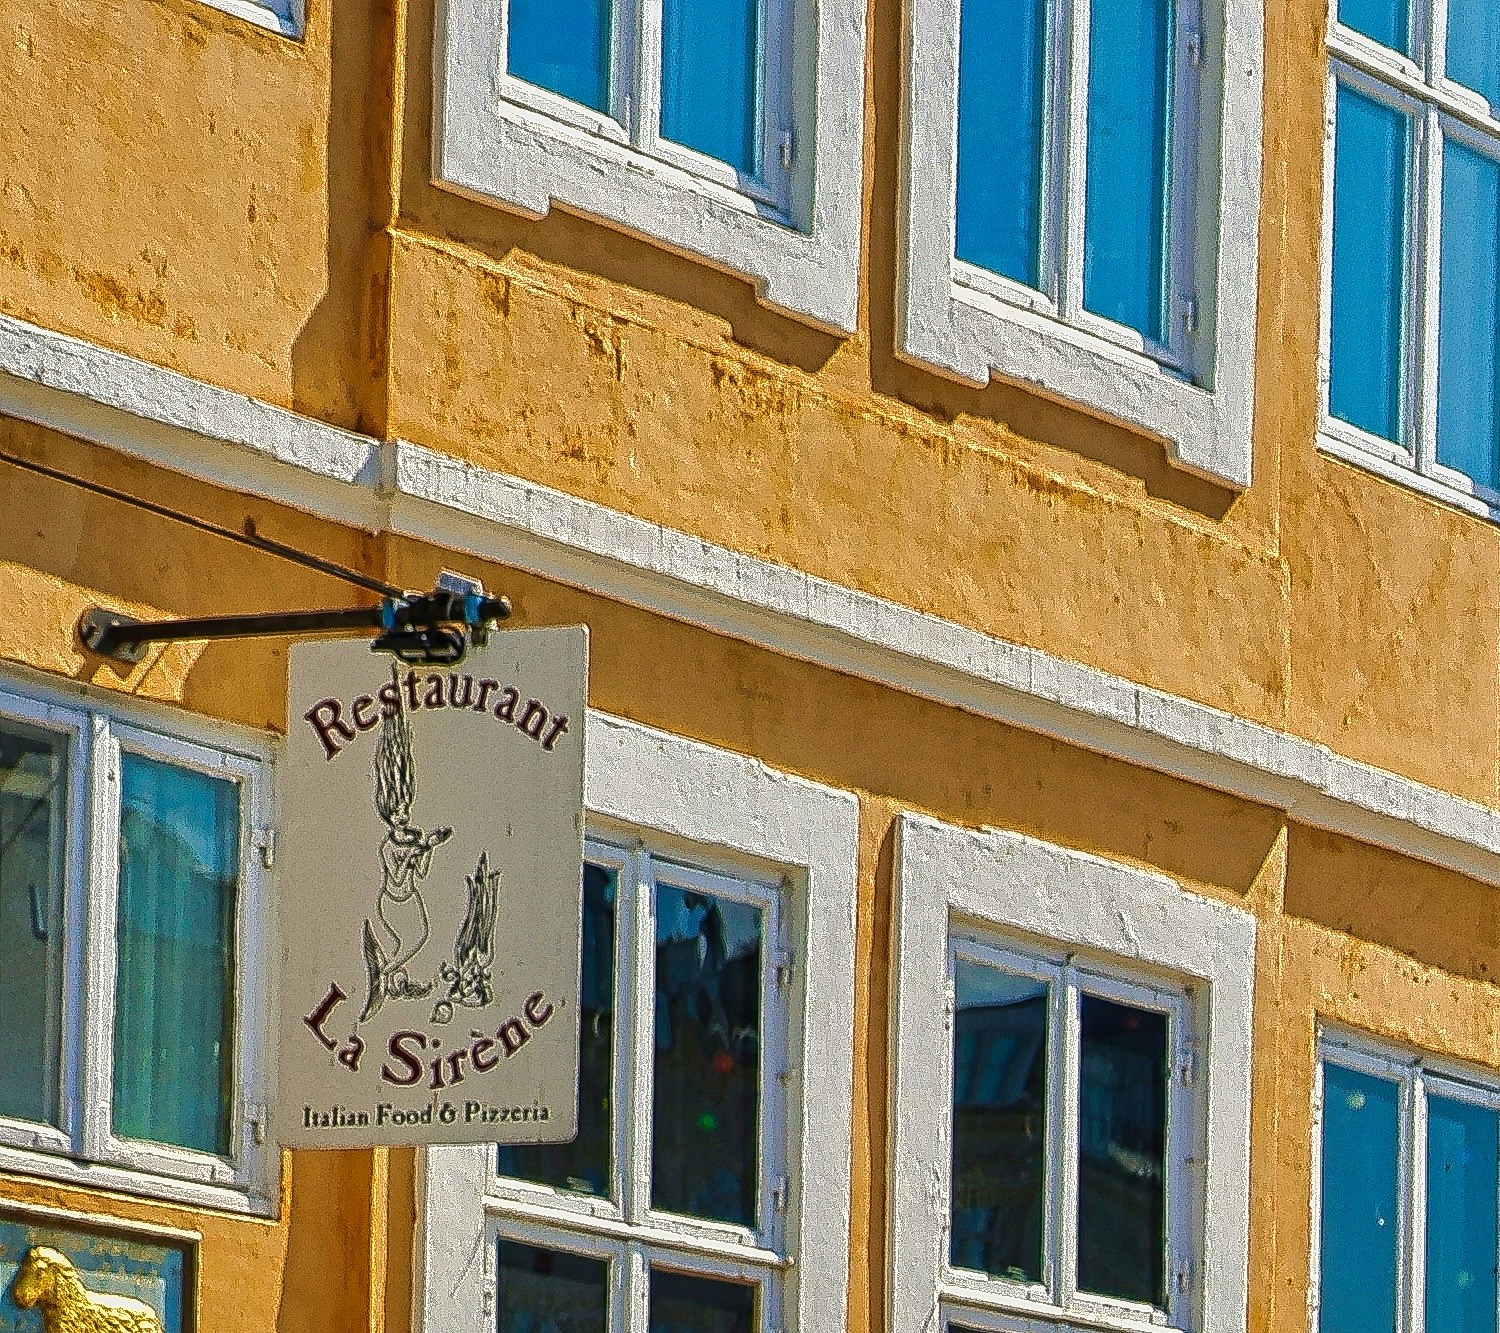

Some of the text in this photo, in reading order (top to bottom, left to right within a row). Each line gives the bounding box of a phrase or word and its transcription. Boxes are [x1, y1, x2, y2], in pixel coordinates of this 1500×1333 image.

[303, 668, 569, 760] Restaurant
[303, 982, 557, 1091] La Sirène
[303, 1099, 550, 1129] Italian Food & Pizzeria
